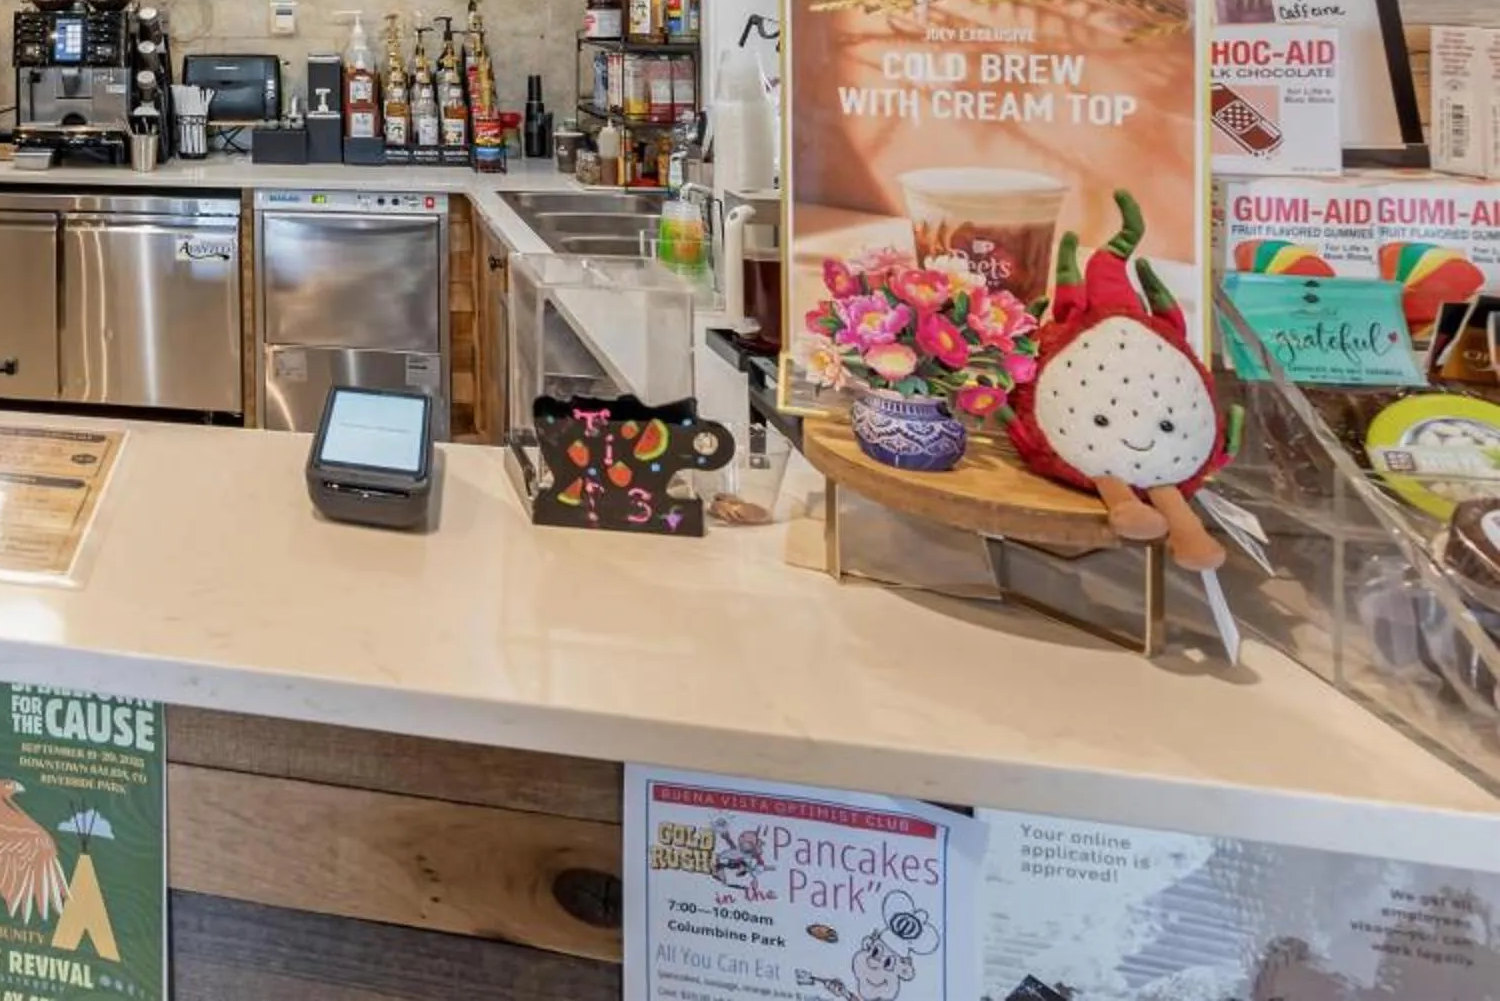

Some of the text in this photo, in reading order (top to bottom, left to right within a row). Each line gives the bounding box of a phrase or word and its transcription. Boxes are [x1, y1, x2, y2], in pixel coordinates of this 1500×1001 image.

[1212, 40, 1335, 65] HOC-AID
[883, 53, 1086, 86] COLD BREW
[1211, 68, 1335, 78] LK CHOCOLATE
[838, 86, 1138, 126] WITH CREAM TOP
[1233, 196, 1372, 224] GUMI-AID
[1231, 224, 1374, 239] FRUIT FLAVORED GUMMIES
[1409, 228, 1469, 240] FLAVORED
[1275, 319, 1390, 363] grateful
[11, 695, 42, 714] FOR
[12, 699, 155, 752] THE CAUSE
[19, 756, 88, 775] DOWNTOWN
[41, 773, 126, 794] RIVERSIDE PARK
[661, 788, 910, 832] BUENA VISTA OPTIMIST CLUB
[658, 821, 716, 851] GOLD
[1020, 823, 1131, 849] Your online
[1020, 844, 1152, 870] application is
[1021, 860, 1119, 883] approved!
[715, 891, 735, 905] in
[744, 880, 778, 902] the
[667, 919, 786, 948] Columbine Park
[9, 950, 95, 989] REVIVAL
[655, 942, 781, 982] All You Can Eat
